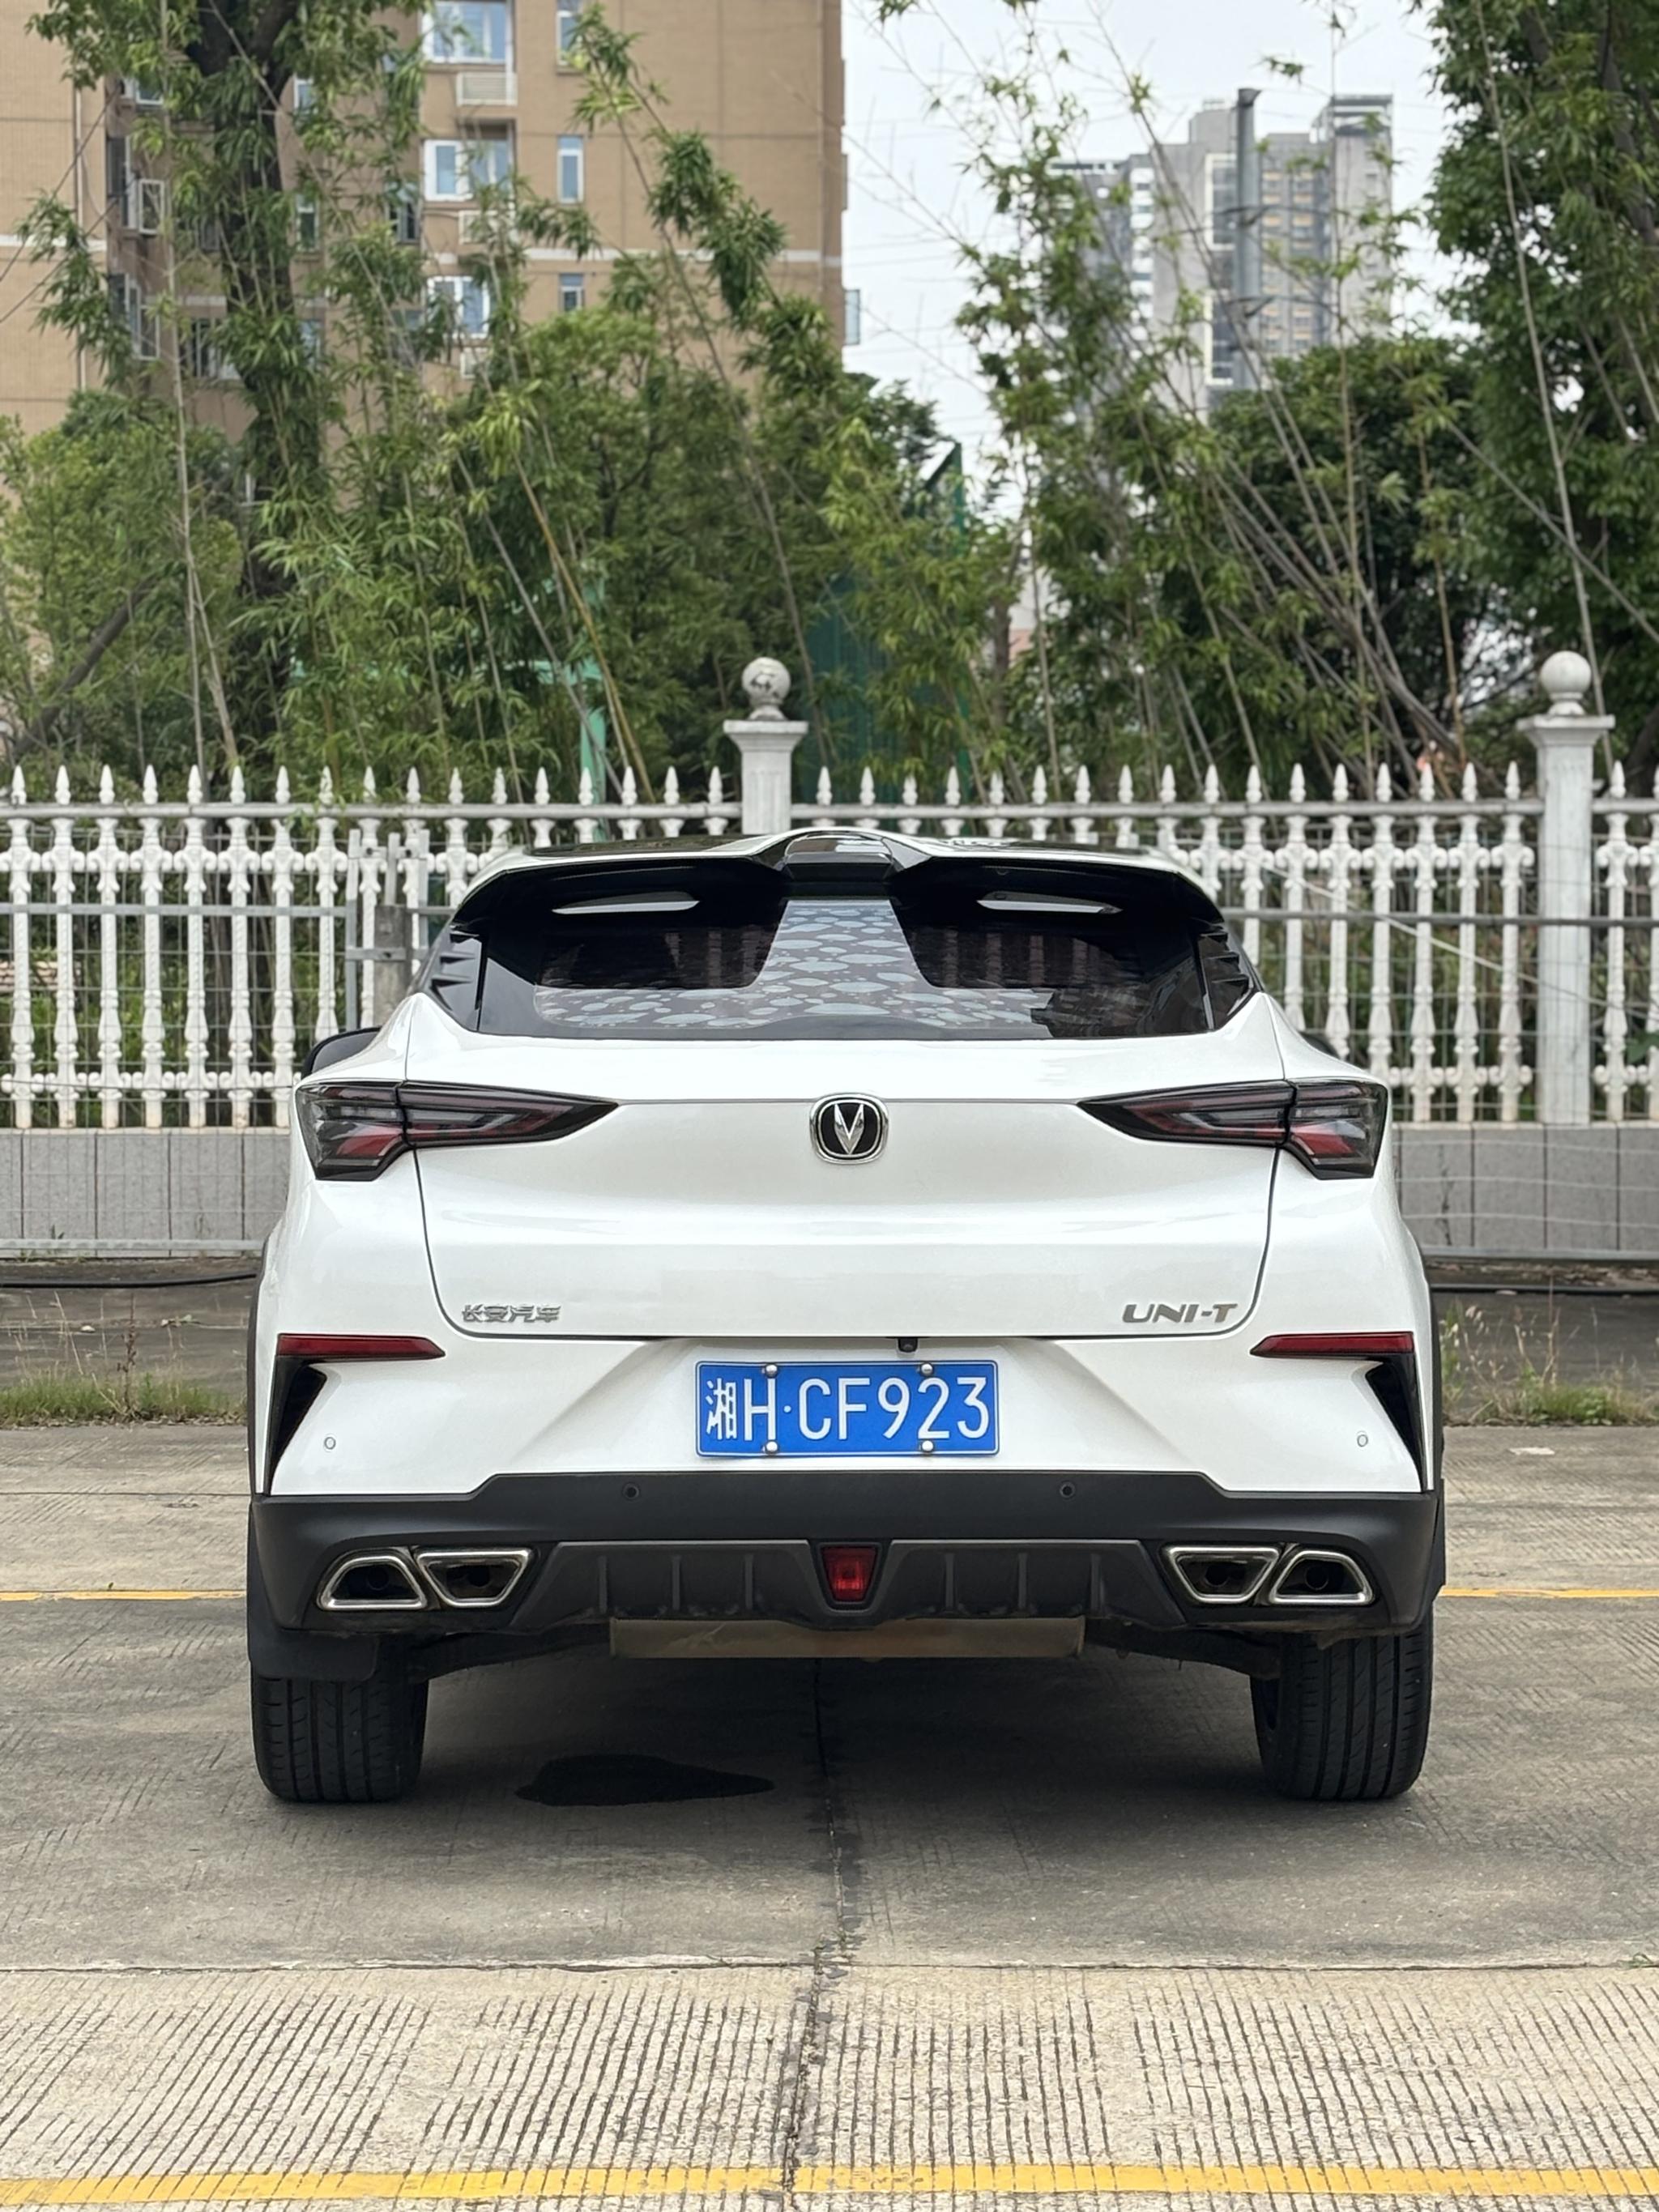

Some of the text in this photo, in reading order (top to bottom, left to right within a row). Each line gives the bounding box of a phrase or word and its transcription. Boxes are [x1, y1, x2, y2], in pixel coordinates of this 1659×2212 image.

[462, 1304, 561, 1323] 长安汽车
[1122, 1303, 1238, 1323] UNI-T
